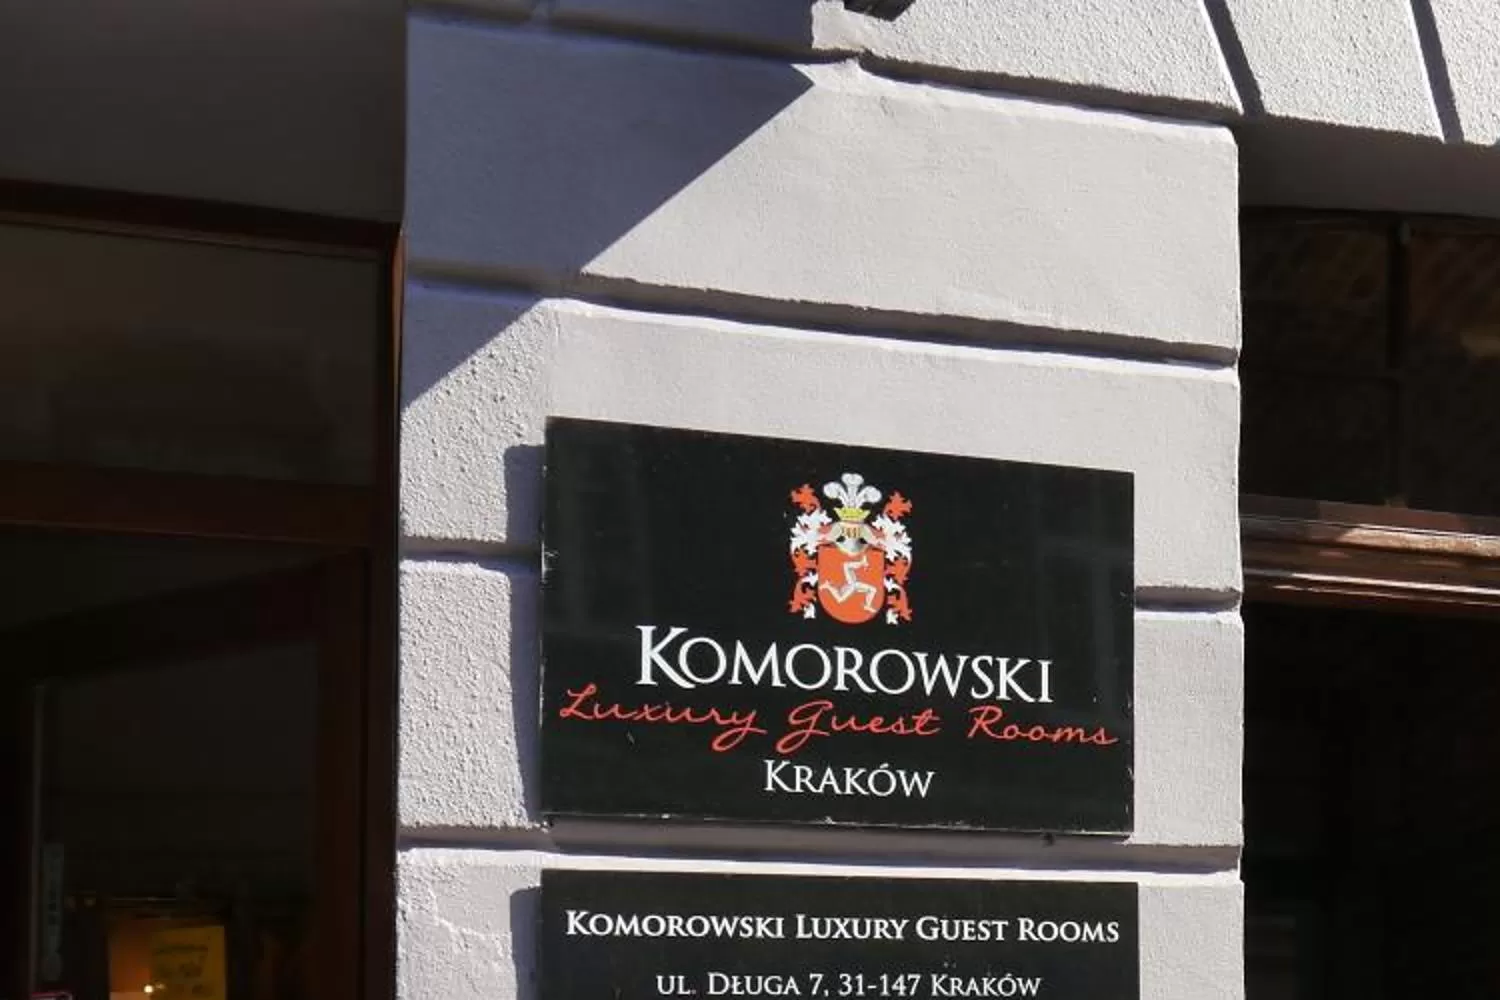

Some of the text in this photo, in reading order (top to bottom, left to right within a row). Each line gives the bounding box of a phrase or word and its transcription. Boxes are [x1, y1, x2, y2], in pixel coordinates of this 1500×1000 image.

[635, 624, 1054, 704] KOMOROWSKI
[558, 684, 1118, 753] Luxury Guest Rooms
[763, 759, 936, 798] KRAKÓW
[565, 909, 1120, 944] KOMOROWSKI LUXURY GUEST ROOMS
[656, 971, 1042, 998] UL. DŁUGA 7, 31-147 KRAKÓW
